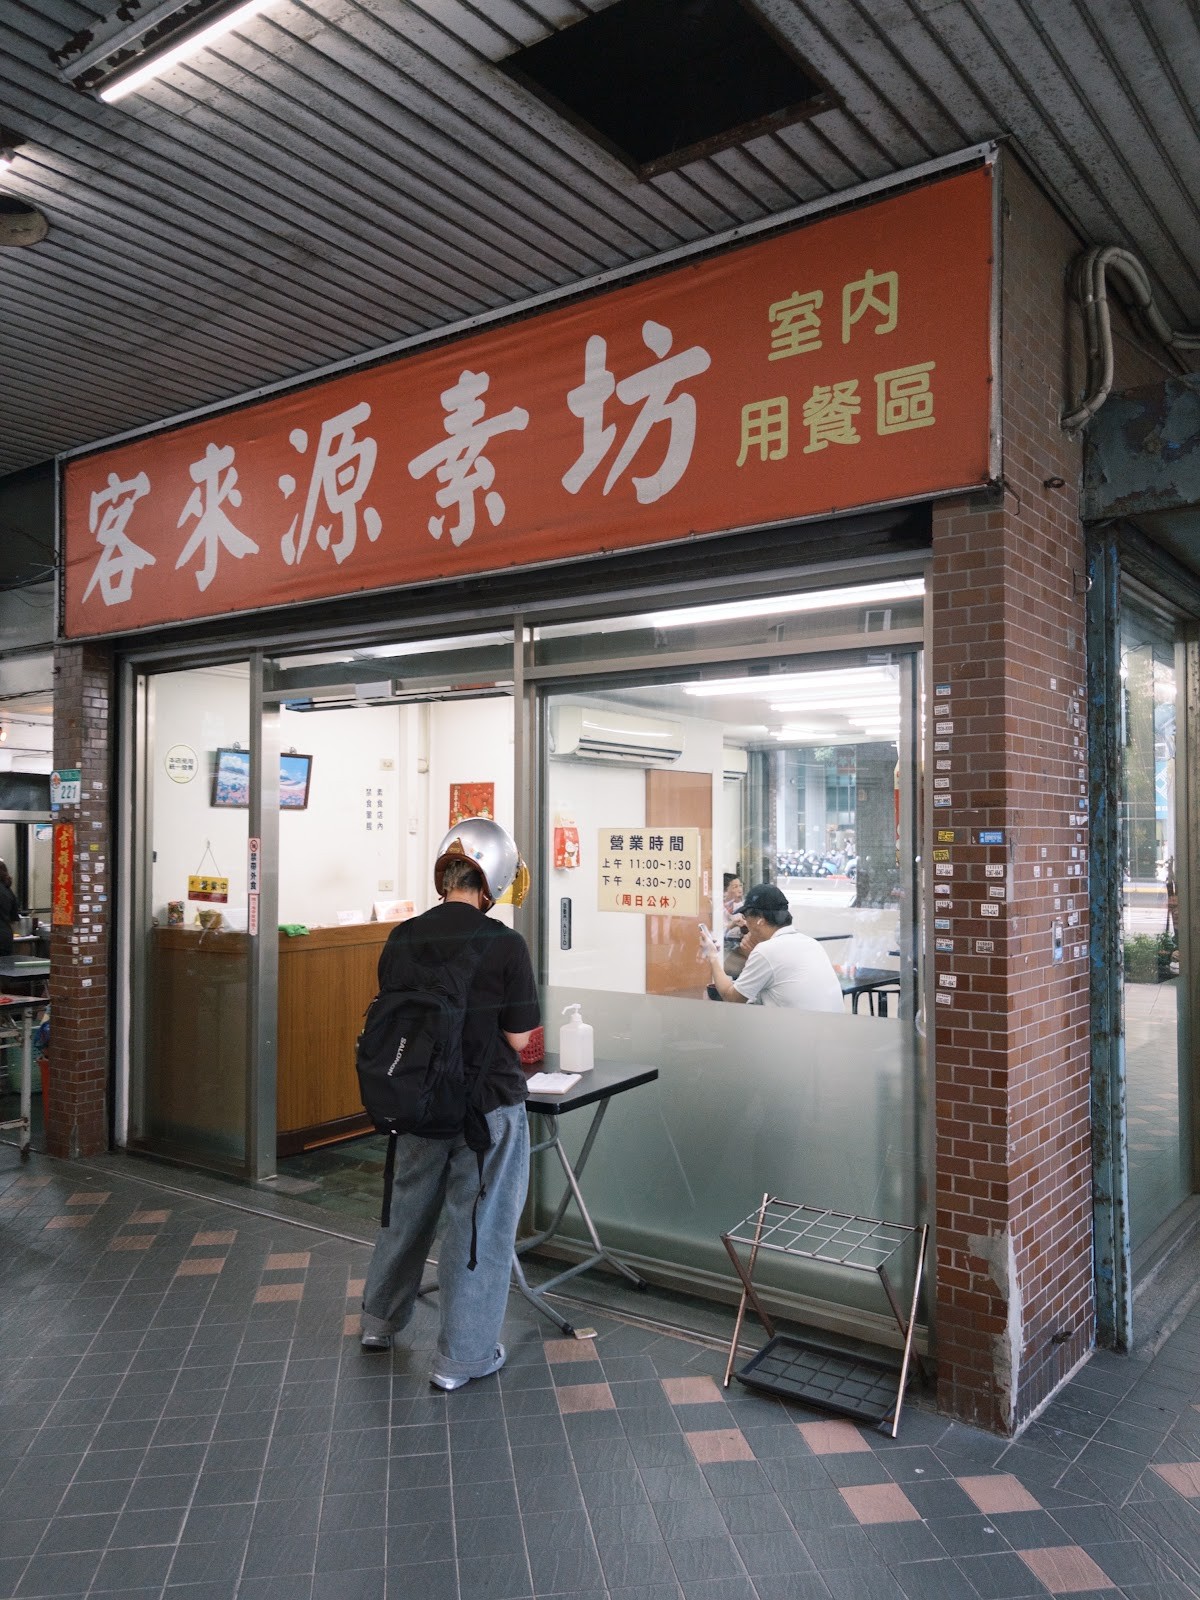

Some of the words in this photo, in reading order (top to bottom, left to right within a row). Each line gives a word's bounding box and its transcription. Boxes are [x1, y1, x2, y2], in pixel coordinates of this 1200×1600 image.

[736, 361, 936, 467] 用餐區
[82, 320, 711, 606] 客來源素坊
[61, 785, 77, 799] 221
[610, 835, 684, 851] 營業時間
[602, 858, 623, 869] 上午
[630, 859, 692, 871] 11:00~1:30
[602, 875, 623, 887] 下午
[635, 877, 692, 889] 4:30~7:00
[387, 1037, 407, 1077] SALOMON
